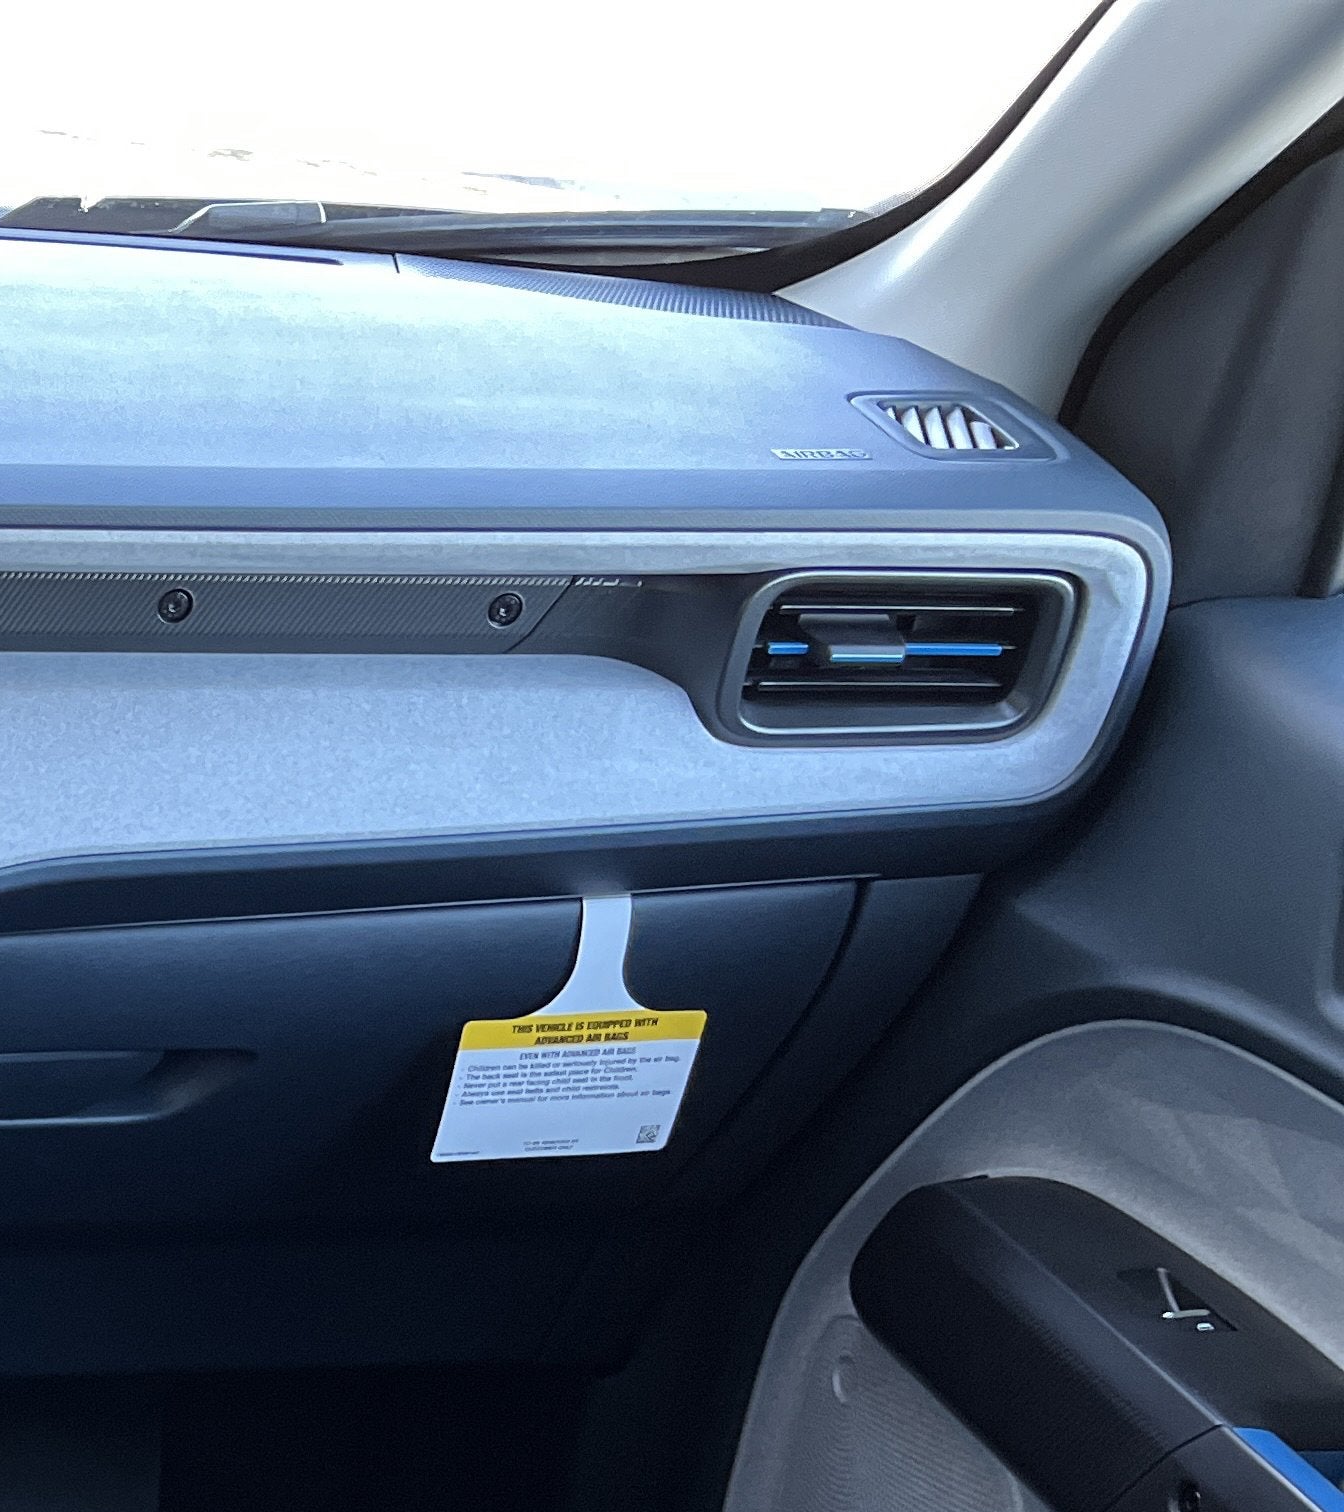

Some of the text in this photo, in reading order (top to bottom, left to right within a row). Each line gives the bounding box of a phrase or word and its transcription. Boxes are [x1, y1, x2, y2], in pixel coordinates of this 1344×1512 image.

[512, 1017, 659, 1033] THIS VEHICLE IS EQUIPPED WITH
[534, 1031, 630, 1045] ADVANCED AIR BAGS
